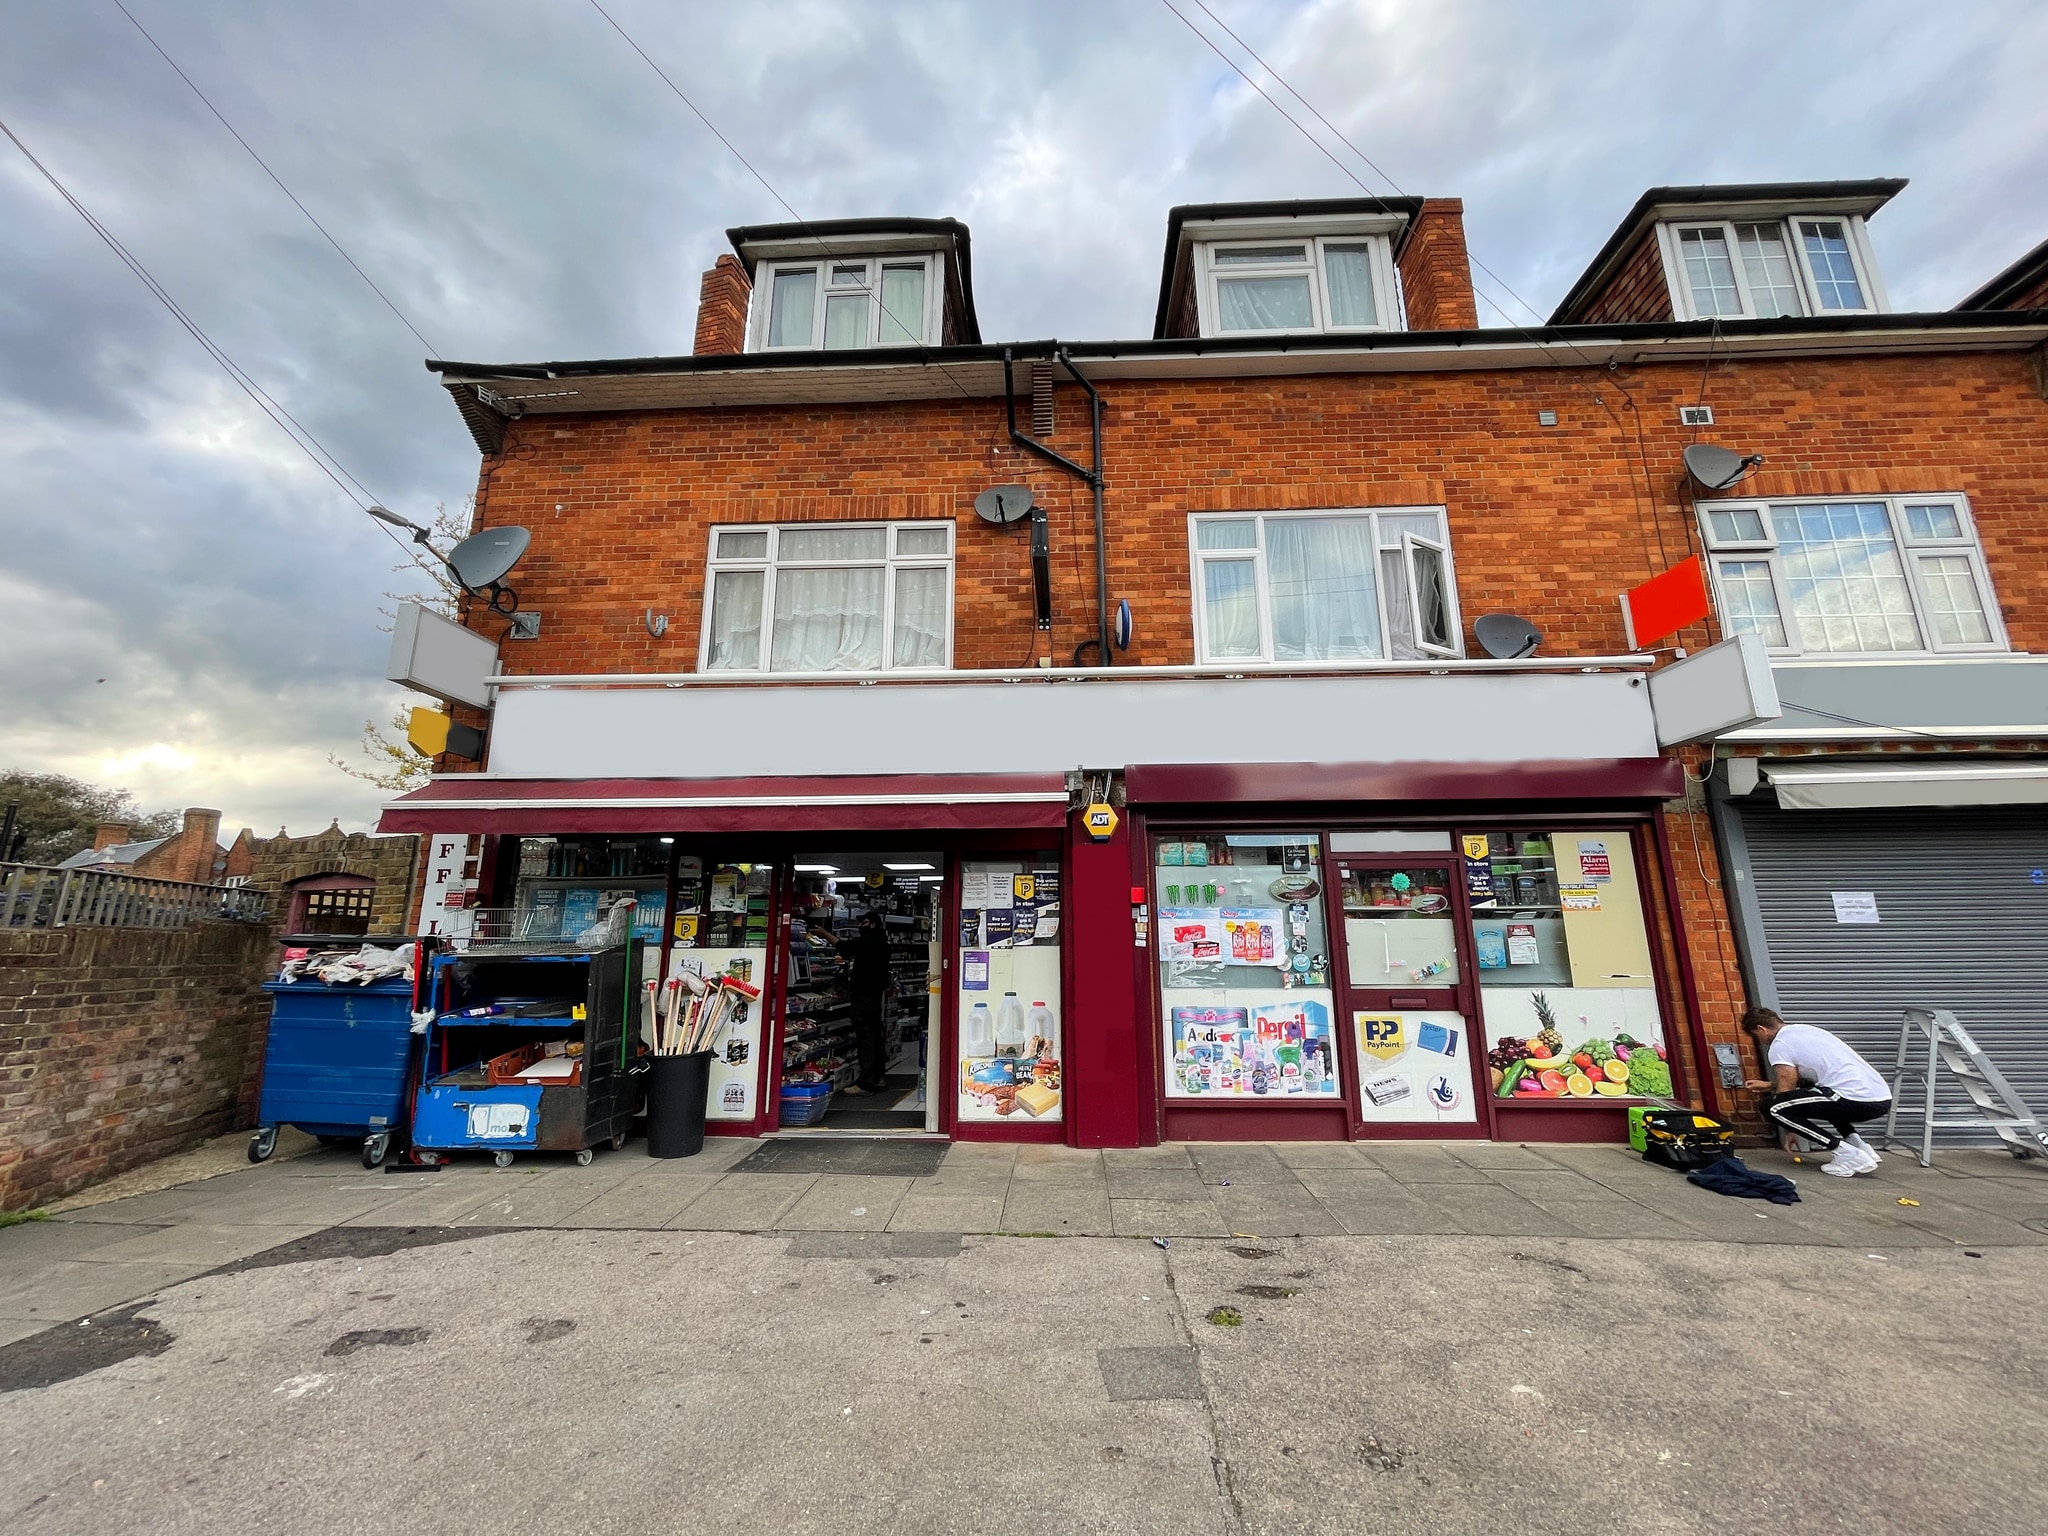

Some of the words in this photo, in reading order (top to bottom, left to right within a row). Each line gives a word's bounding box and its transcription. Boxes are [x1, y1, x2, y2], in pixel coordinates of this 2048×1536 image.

[1091, 814, 1109, 825] ADT
[1421, 1024, 1441, 1033] oyster
[1373, 1078, 1397, 1088] NEWS
